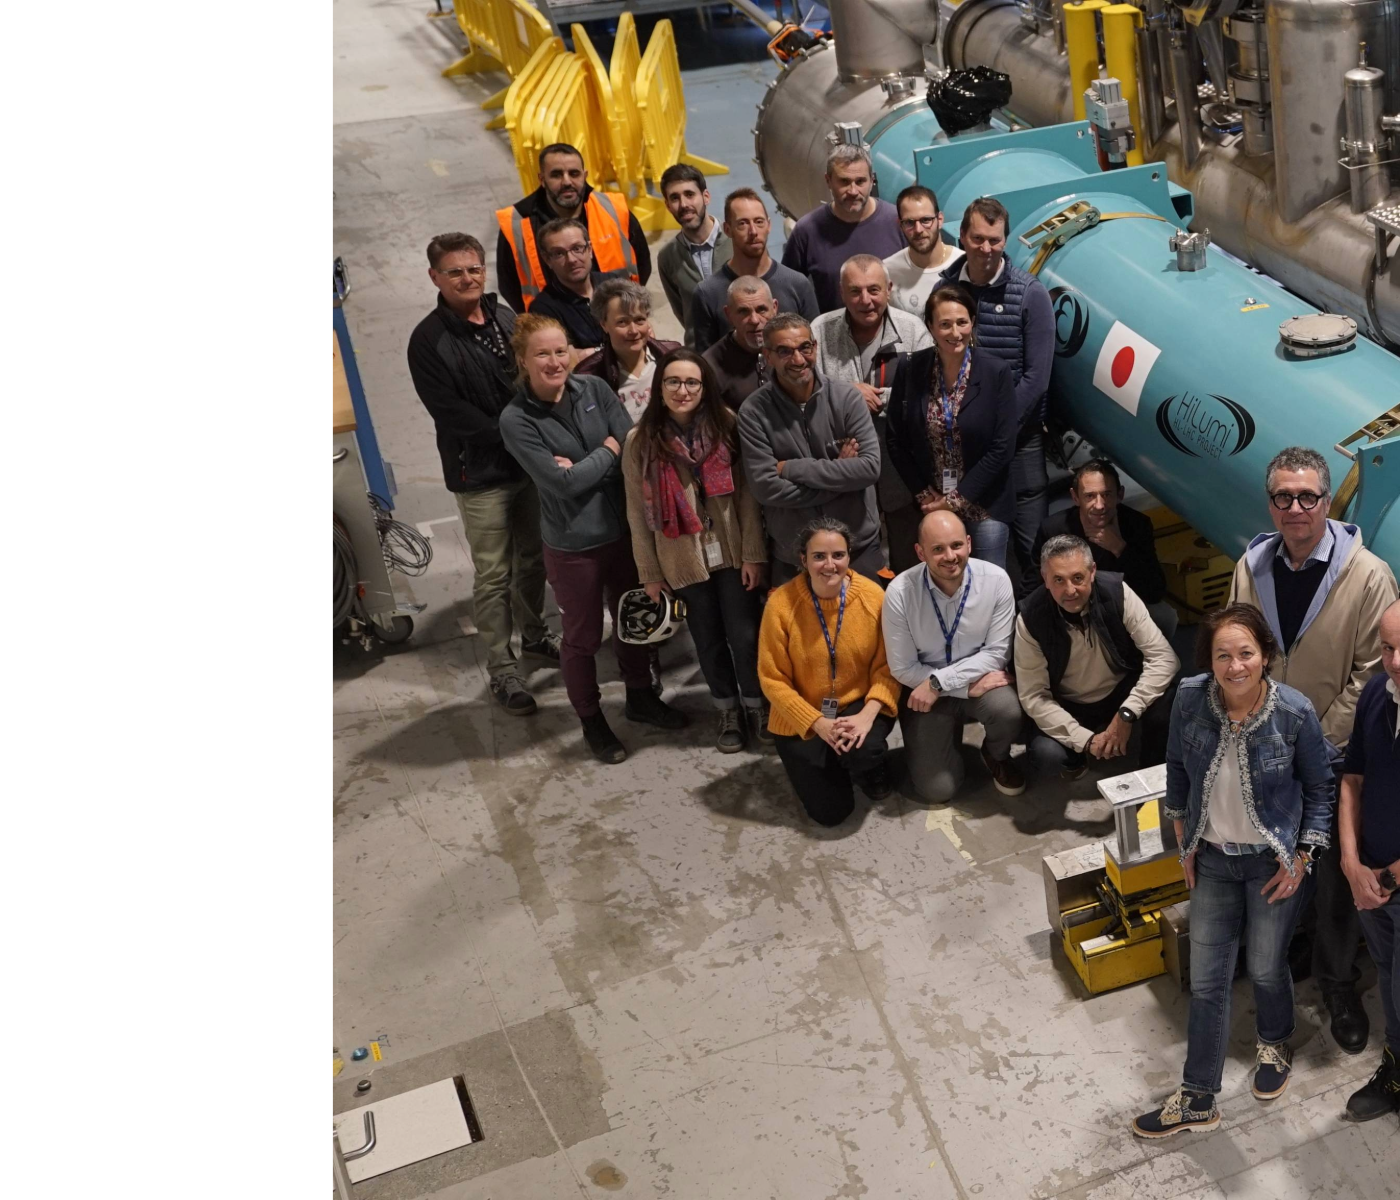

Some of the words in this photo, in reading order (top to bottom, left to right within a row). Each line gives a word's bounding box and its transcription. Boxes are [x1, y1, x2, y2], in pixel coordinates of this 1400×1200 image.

[1173, 417, 1196, 441] HL-LHC
[1196, 435, 1222, 460] PROJECT
[1176, 391, 1235, 449] HiLumi
